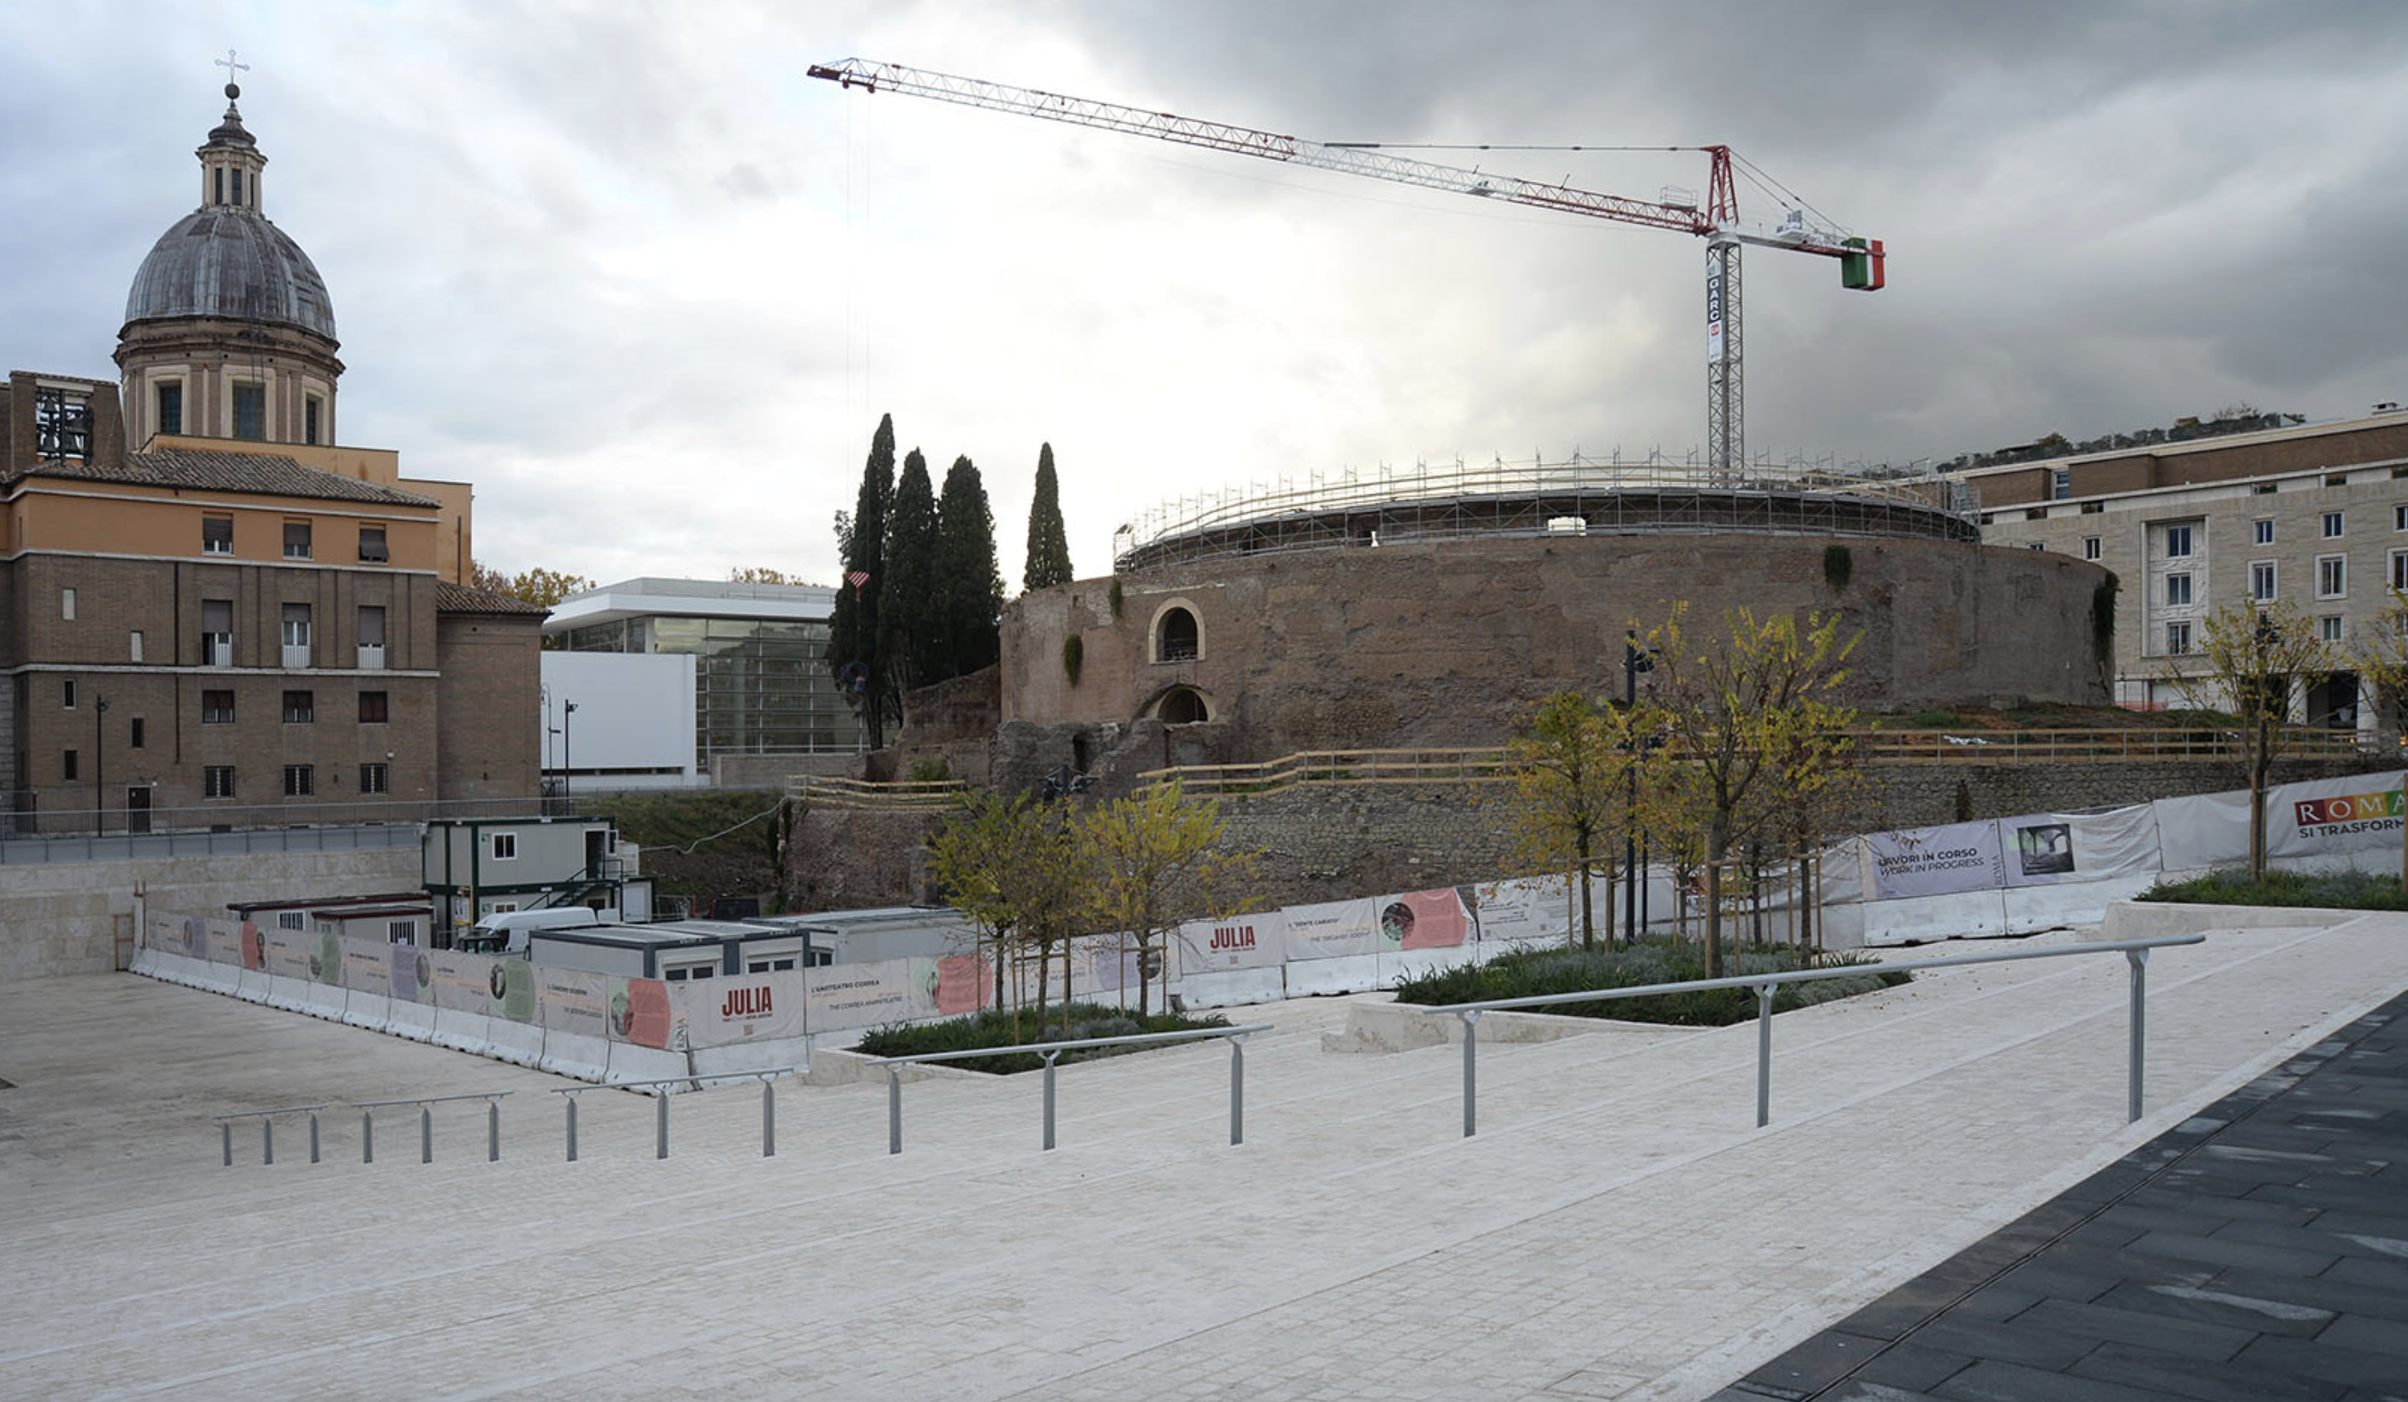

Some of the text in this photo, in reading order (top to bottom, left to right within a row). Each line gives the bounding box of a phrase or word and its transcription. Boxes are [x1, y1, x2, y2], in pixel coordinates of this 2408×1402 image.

[1709, 279, 1719, 321] GARC
[2300, 794, 2405, 822] ROMA
[2299, 827, 2314, 839] SI
[1878, 848, 1977, 867] LAVORI IN CORSO
[1880, 857, 1985, 877] WORK IN PROGRESS
[1210, 926, 1255, 949] JULIA
[722, 986, 772, 1017] JULIA
